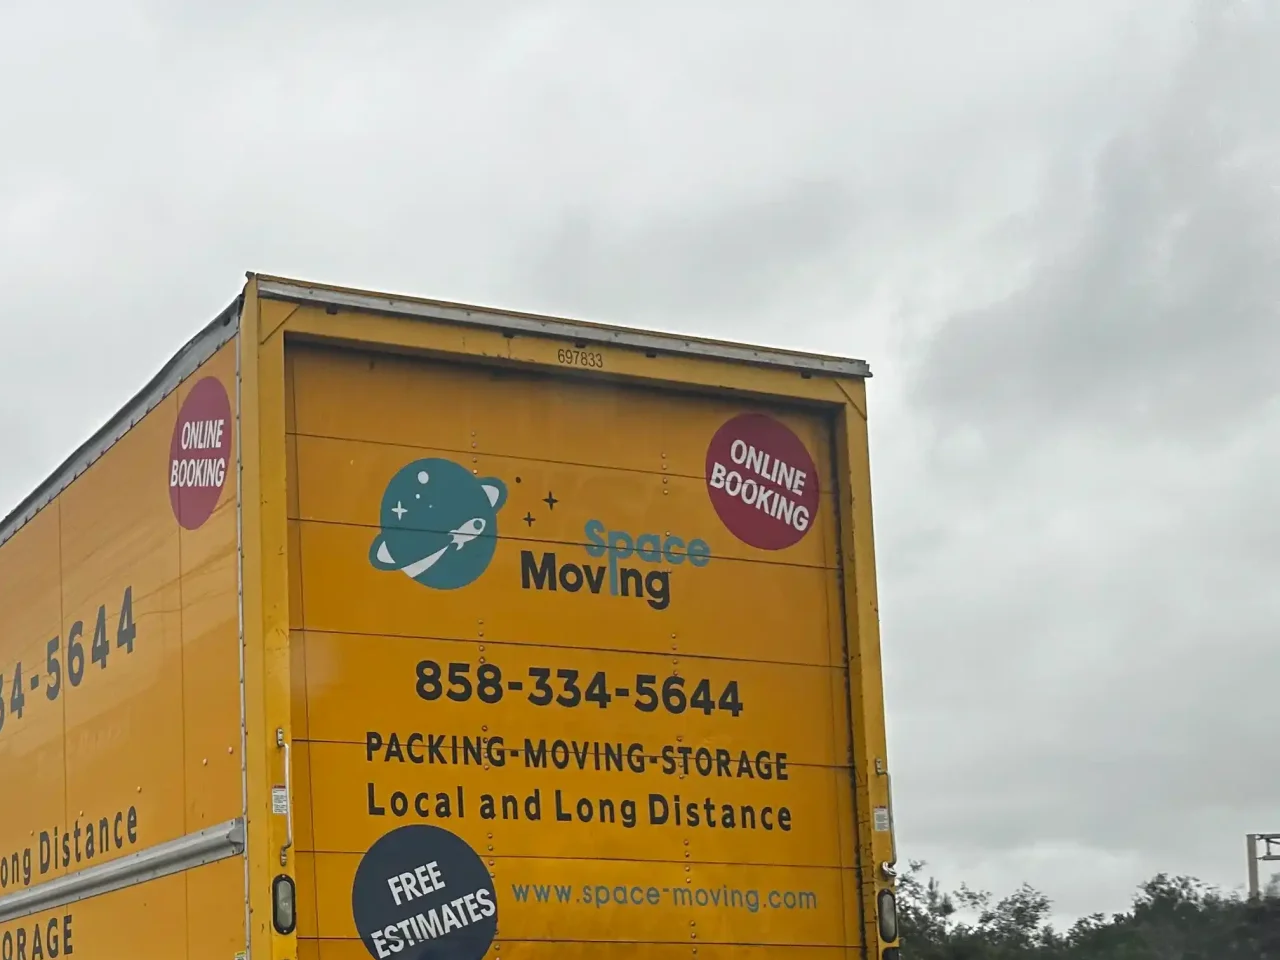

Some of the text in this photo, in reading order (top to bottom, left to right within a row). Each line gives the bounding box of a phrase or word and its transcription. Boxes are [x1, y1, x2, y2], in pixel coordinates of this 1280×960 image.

[557, 348, 603, 368] 697833
[181, 419, 224, 450] ONLINE
[170, 457, 225, 488] BOOKING
[730, 439, 807, 496] ONLINE
[709, 462, 810, 532] BOOKING
[520, 550, 671, 610] Moving
[584, 518, 711, 596] Space
[415, 660, 744, 717] 858-334-5644
[367, 782, 792, 832] Local and Long Distance
[40, 806, 137, 874] Distance
[388, 860, 447, 906] FREE
[512, 881, 819, 914] www.space-moving.com
[370, 888, 497, 959] ESTIMATES
